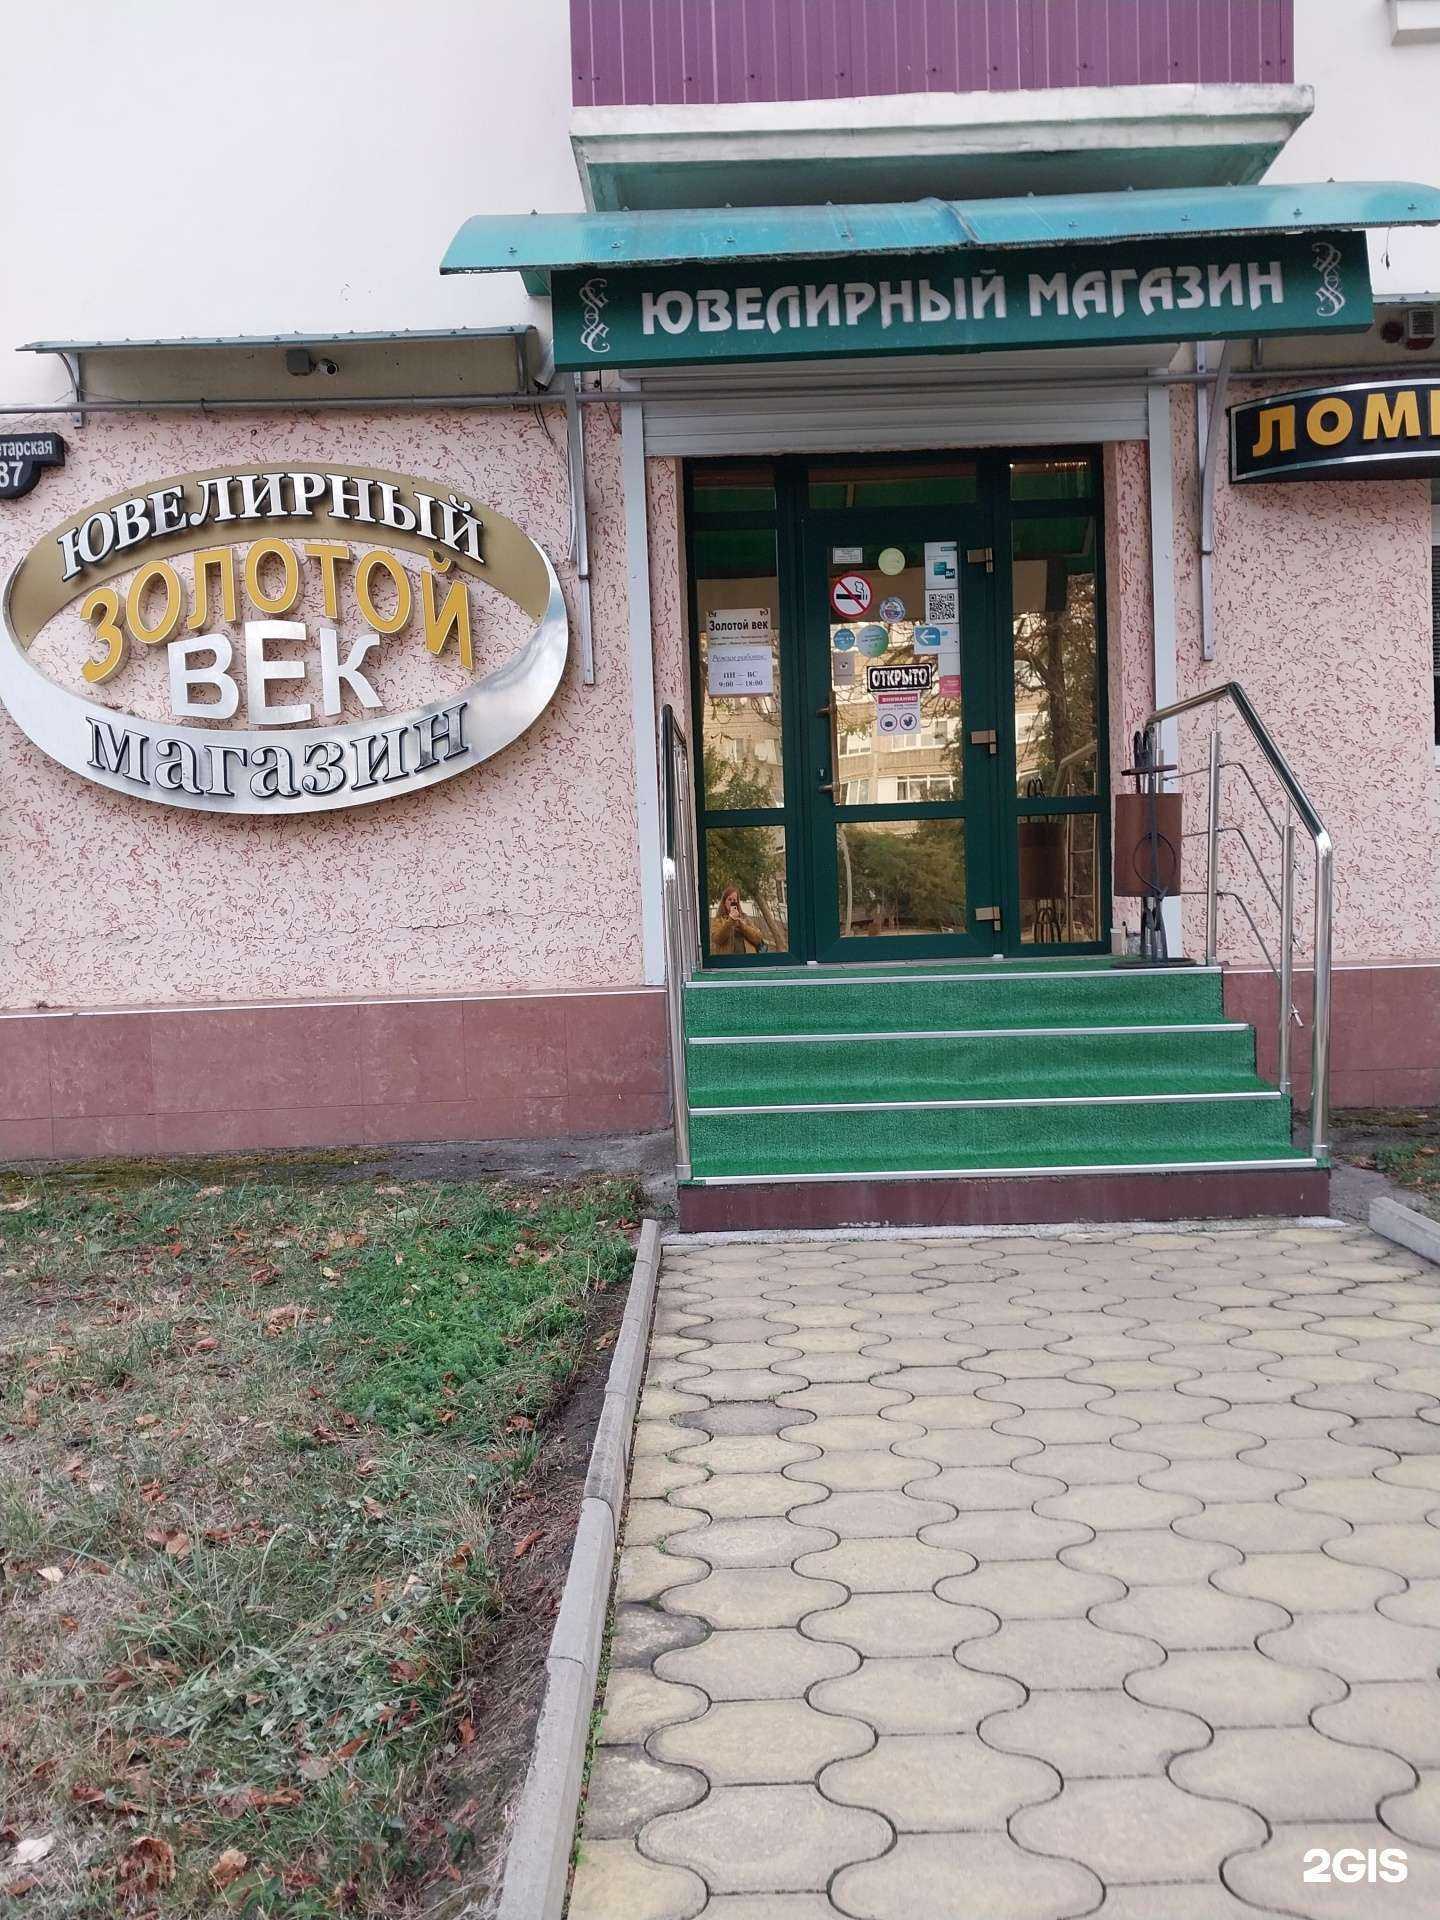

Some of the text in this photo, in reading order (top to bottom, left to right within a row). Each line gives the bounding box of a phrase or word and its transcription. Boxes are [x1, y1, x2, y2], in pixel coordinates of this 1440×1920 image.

[641, 261, 1284, 336] ЮВЕЛИРНЫЙ МАГАЗИН
[57, 472, 485, 583] ЮВЕЛИРНЫЙ
[80, 538, 474, 683] ЗОЛОТОЙ
[709, 619, 769, 631] Золотой век
[871, 668, 928, 687] ОТКРЫТО
